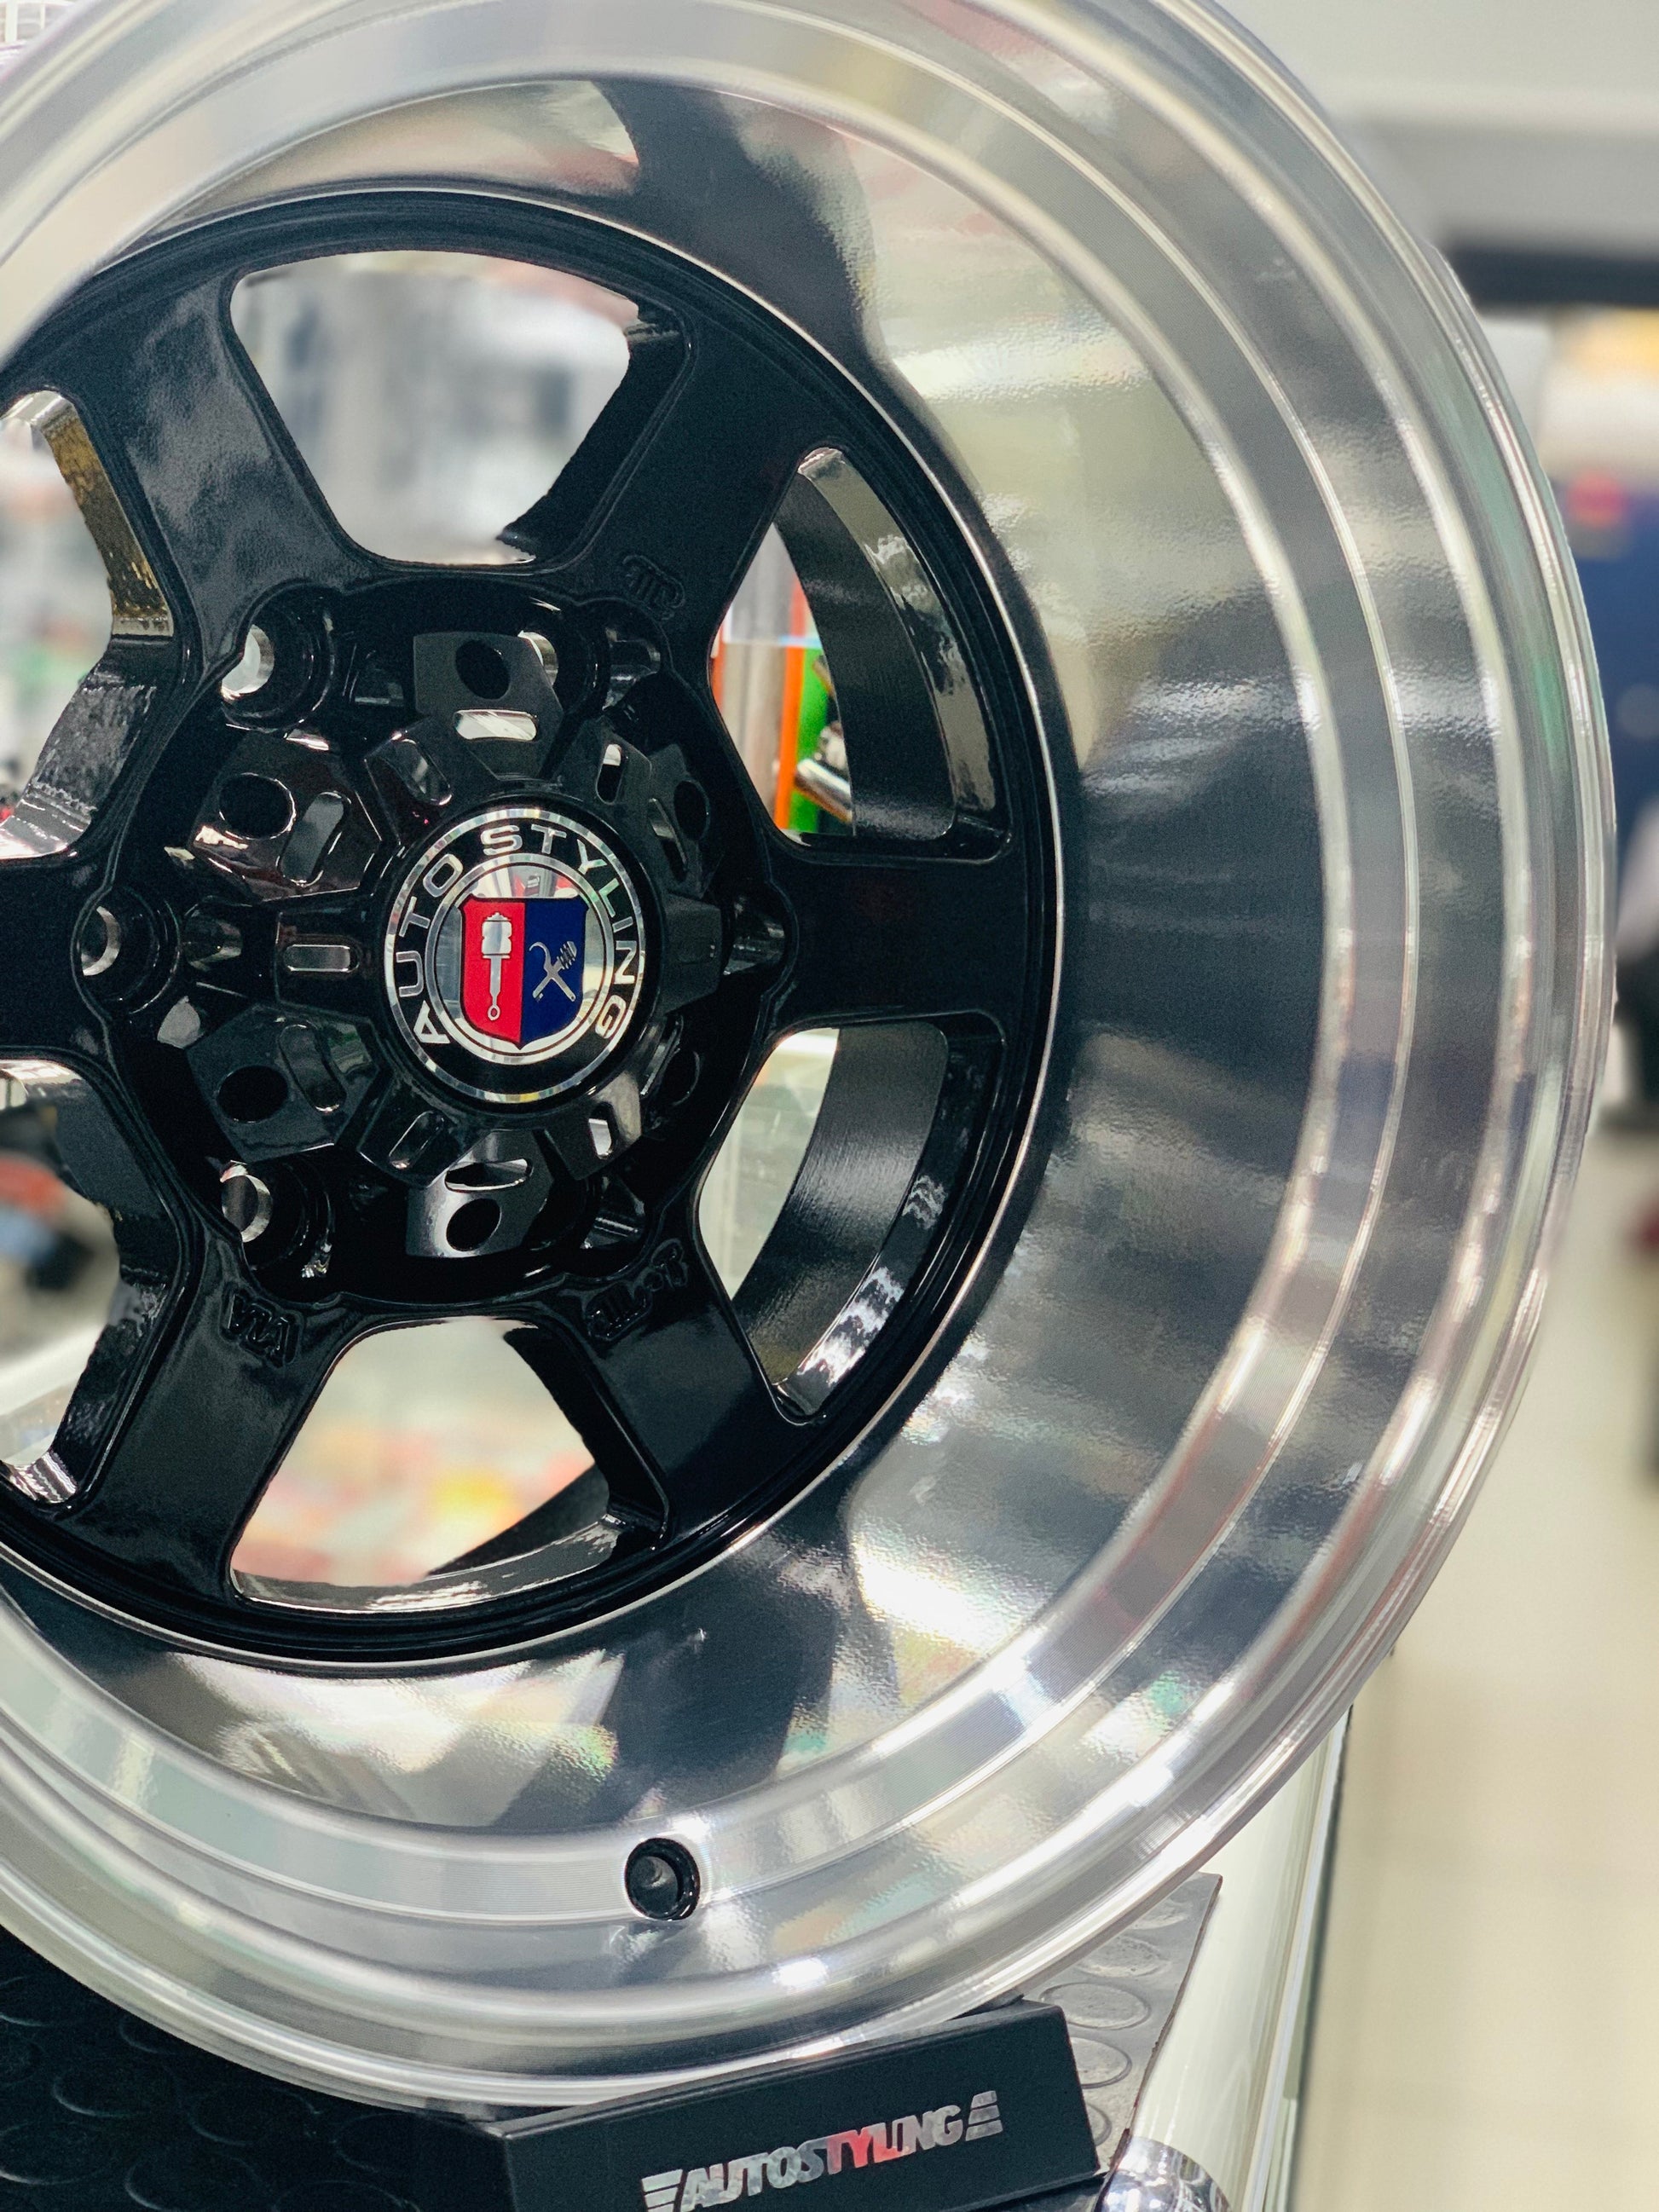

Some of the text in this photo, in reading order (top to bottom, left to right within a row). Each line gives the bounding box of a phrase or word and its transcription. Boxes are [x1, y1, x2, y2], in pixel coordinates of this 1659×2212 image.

[396, 823, 638, 1045] AUTO STYLING
[679, 2104, 964, 2212] AUTOSTYLING
